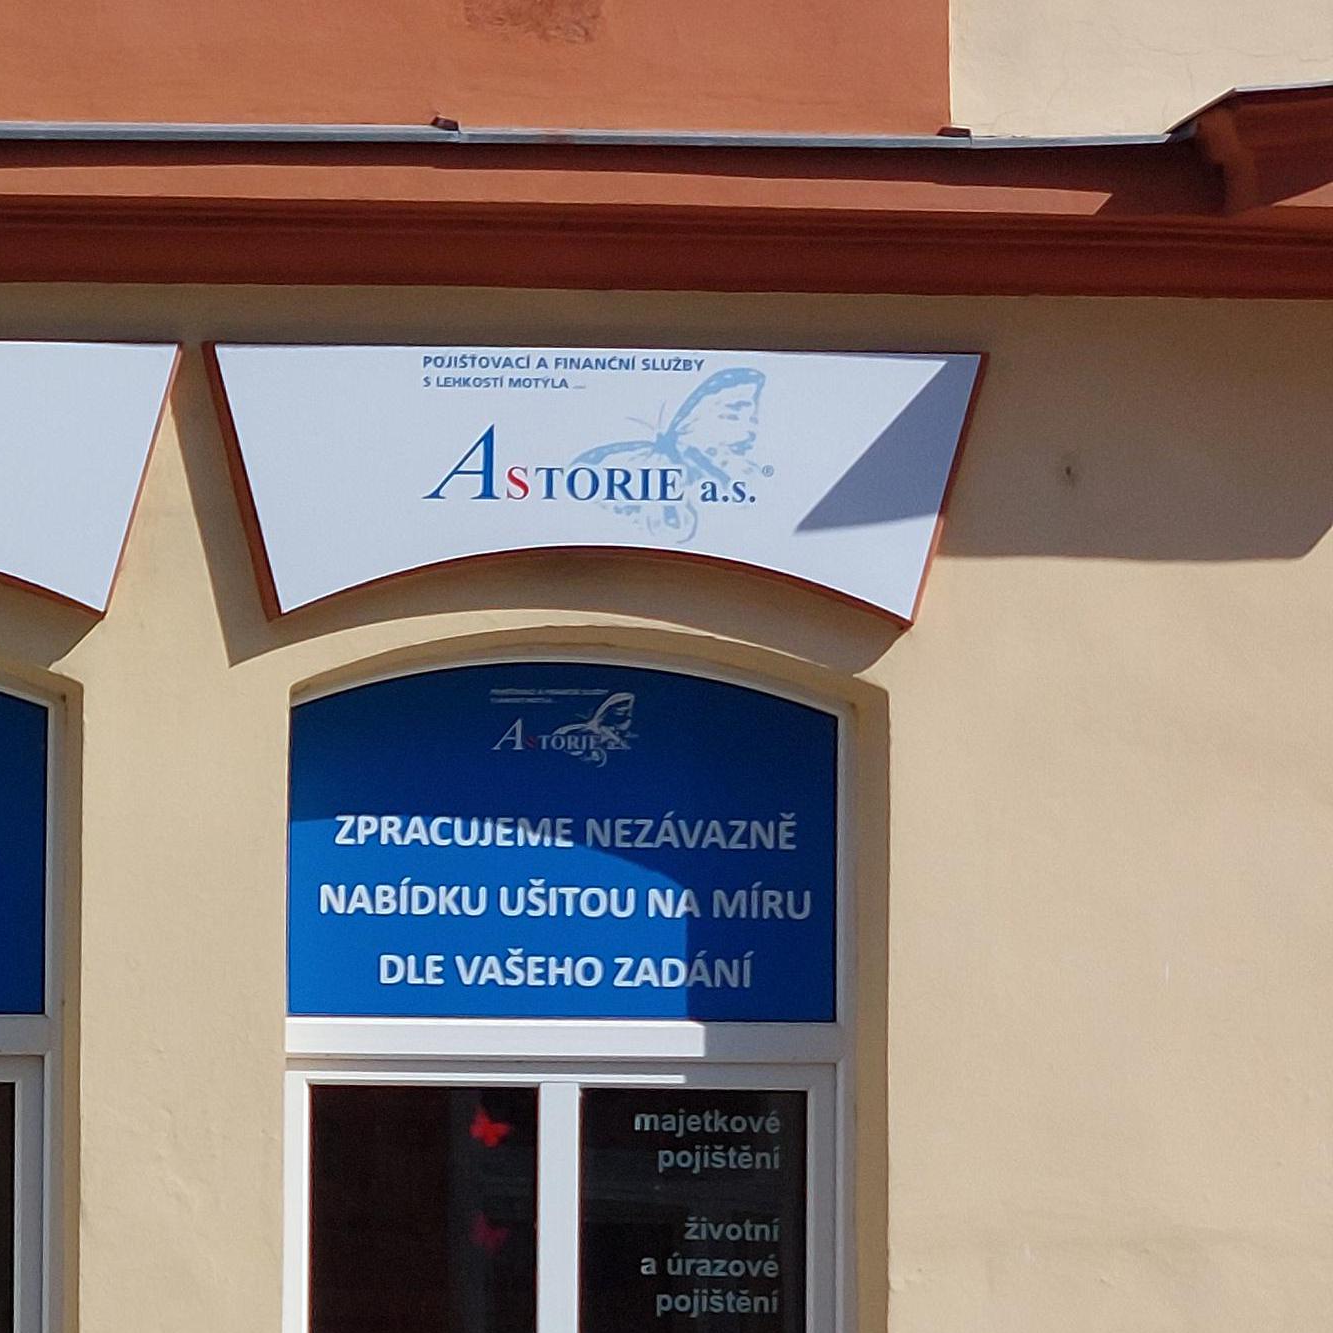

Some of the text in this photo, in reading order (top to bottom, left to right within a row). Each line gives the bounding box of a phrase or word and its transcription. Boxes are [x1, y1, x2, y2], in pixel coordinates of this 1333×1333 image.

[537, 356, 549, 370] A
[554, 355, 635, 371] FINANČNÍ
[641, 355, 704, 372] SLUŽBY
[423, 376, 431, 388] S
[436, 375, 503, 388] LEHKOSTÍ
[508, 376, 569, 389] MOTÝLA
[700, 480, 756, 503] a.s.
[334, 812, 797, 850] ZPRACUJEME NEZÁVAZNĚ
[319, 877, 812, 920] NABÍDKU UŠITOU NA MÍRU
[379, 948, 754, 988] DLE VAŠEHO ZADÁNÍ
[634, 1108, 781, 1137] majetkové
[658, 1145, 780, 1173] pojištění
[684, 1216, 781, 1242] životní
[641, 1253, 779, 1277] a úrazové
[656, 1289, 778, 1317] pojištění
